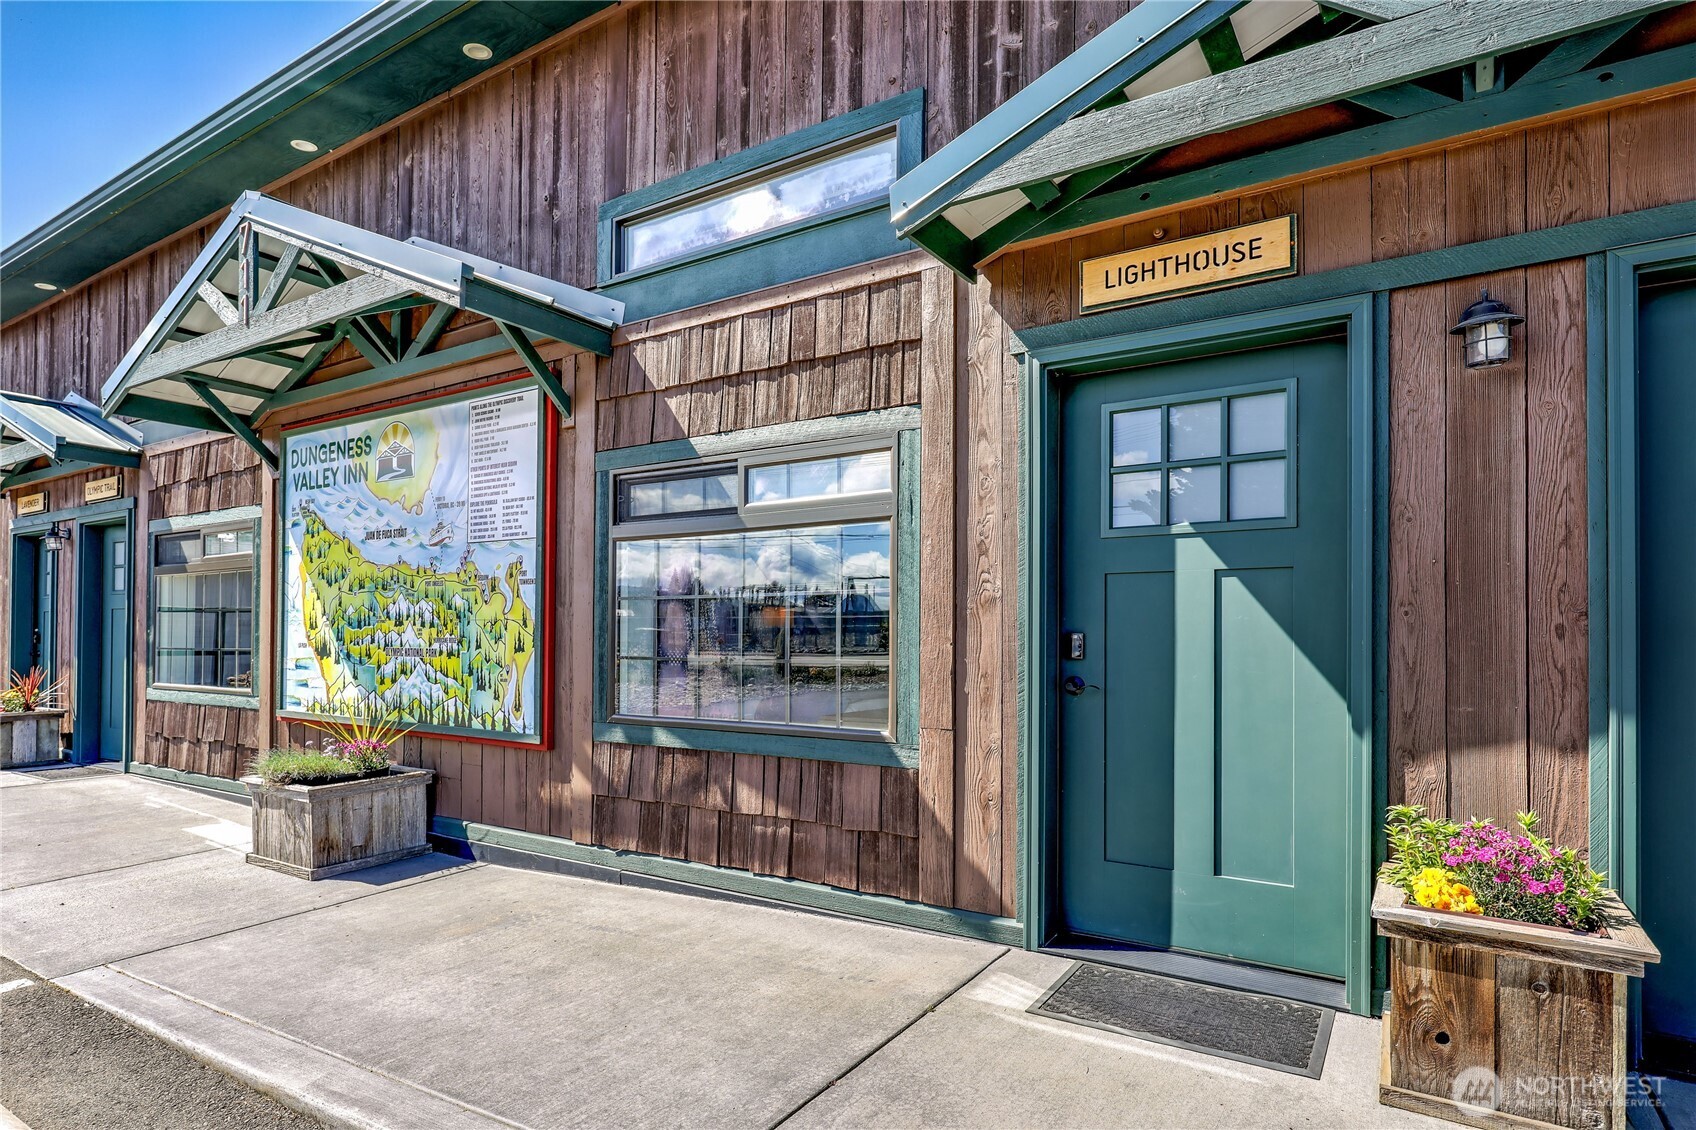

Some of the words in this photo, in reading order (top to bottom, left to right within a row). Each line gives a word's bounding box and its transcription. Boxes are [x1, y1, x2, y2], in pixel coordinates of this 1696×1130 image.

[1105, 237, 1262, 290] LIGHTHOUSE
[291, 435, 372, 470] DUNGENESS
[293, 466, 340, 492] VALLEY
[344, 462, 368, 485] INN
[87, 484, 104, 496] OLYMPIC
[104, 482, 116, 492] TRAIL
[21, 498, 40, 510] LAVENDER
[364, 530, 376, 540] JUAN
[376, 530, 382, 540] DE
[382, 528, 392, 538] FUCA
[392, 527, 408, 538] STRAIT
[385, 647, 404, 656] OLYMPIC
[404, 648, 424, 658] NATIONAL
[426, 648, 438, 658] PARK
